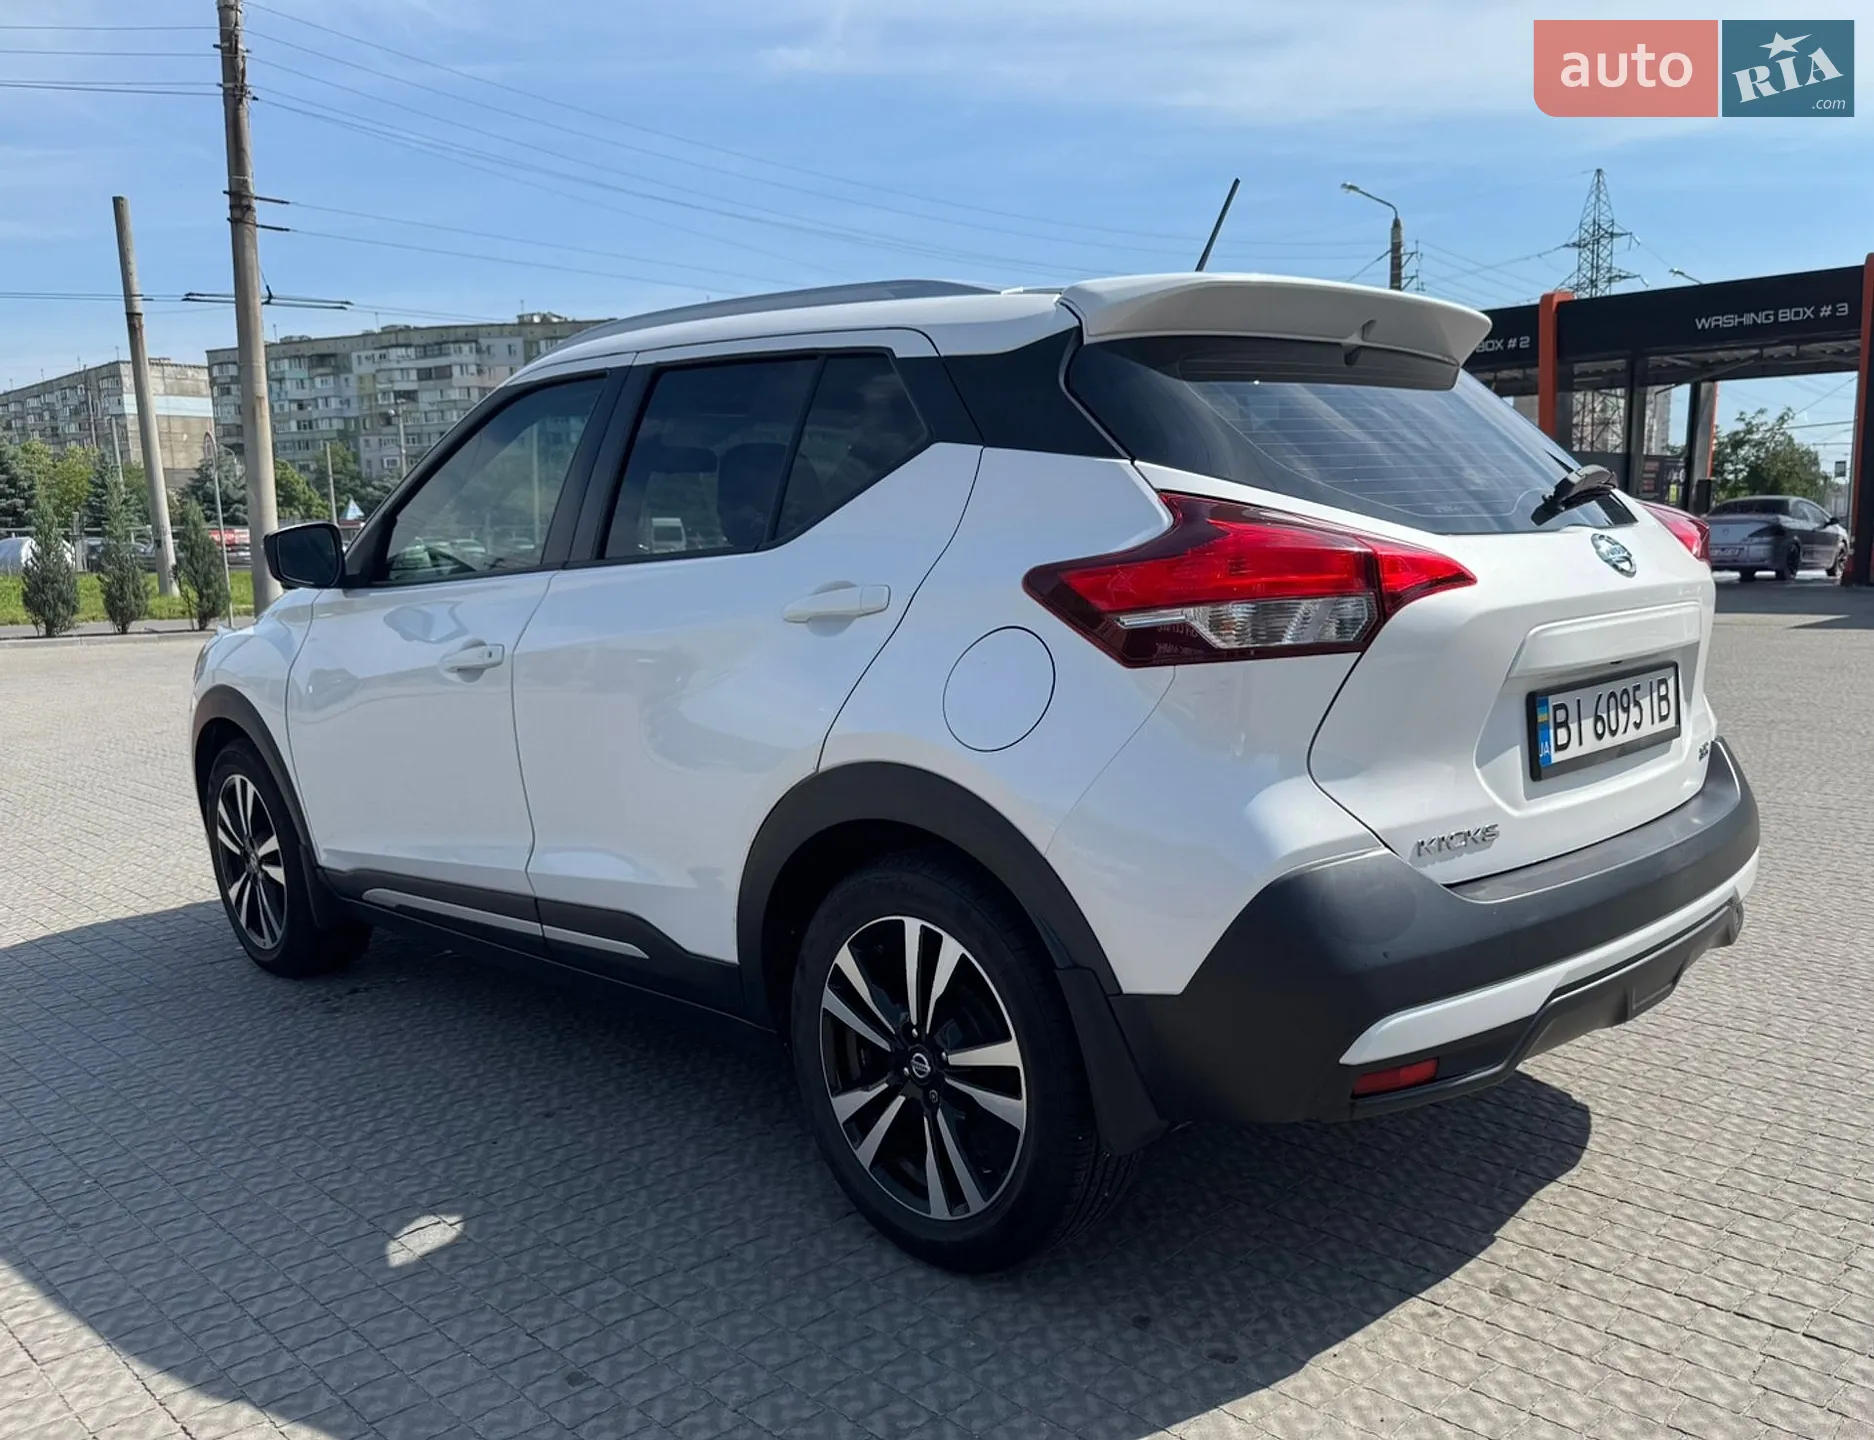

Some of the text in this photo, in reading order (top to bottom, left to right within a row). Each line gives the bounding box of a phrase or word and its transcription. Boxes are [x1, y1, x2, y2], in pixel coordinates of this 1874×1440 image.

[1695, 310, 1774, 330] WASHING
[1778, 307, 1815, 322] BOX
[1552, 677, 1671, 752] BI 6095 IB
[1416, 823, 1500, 857] KICKS
